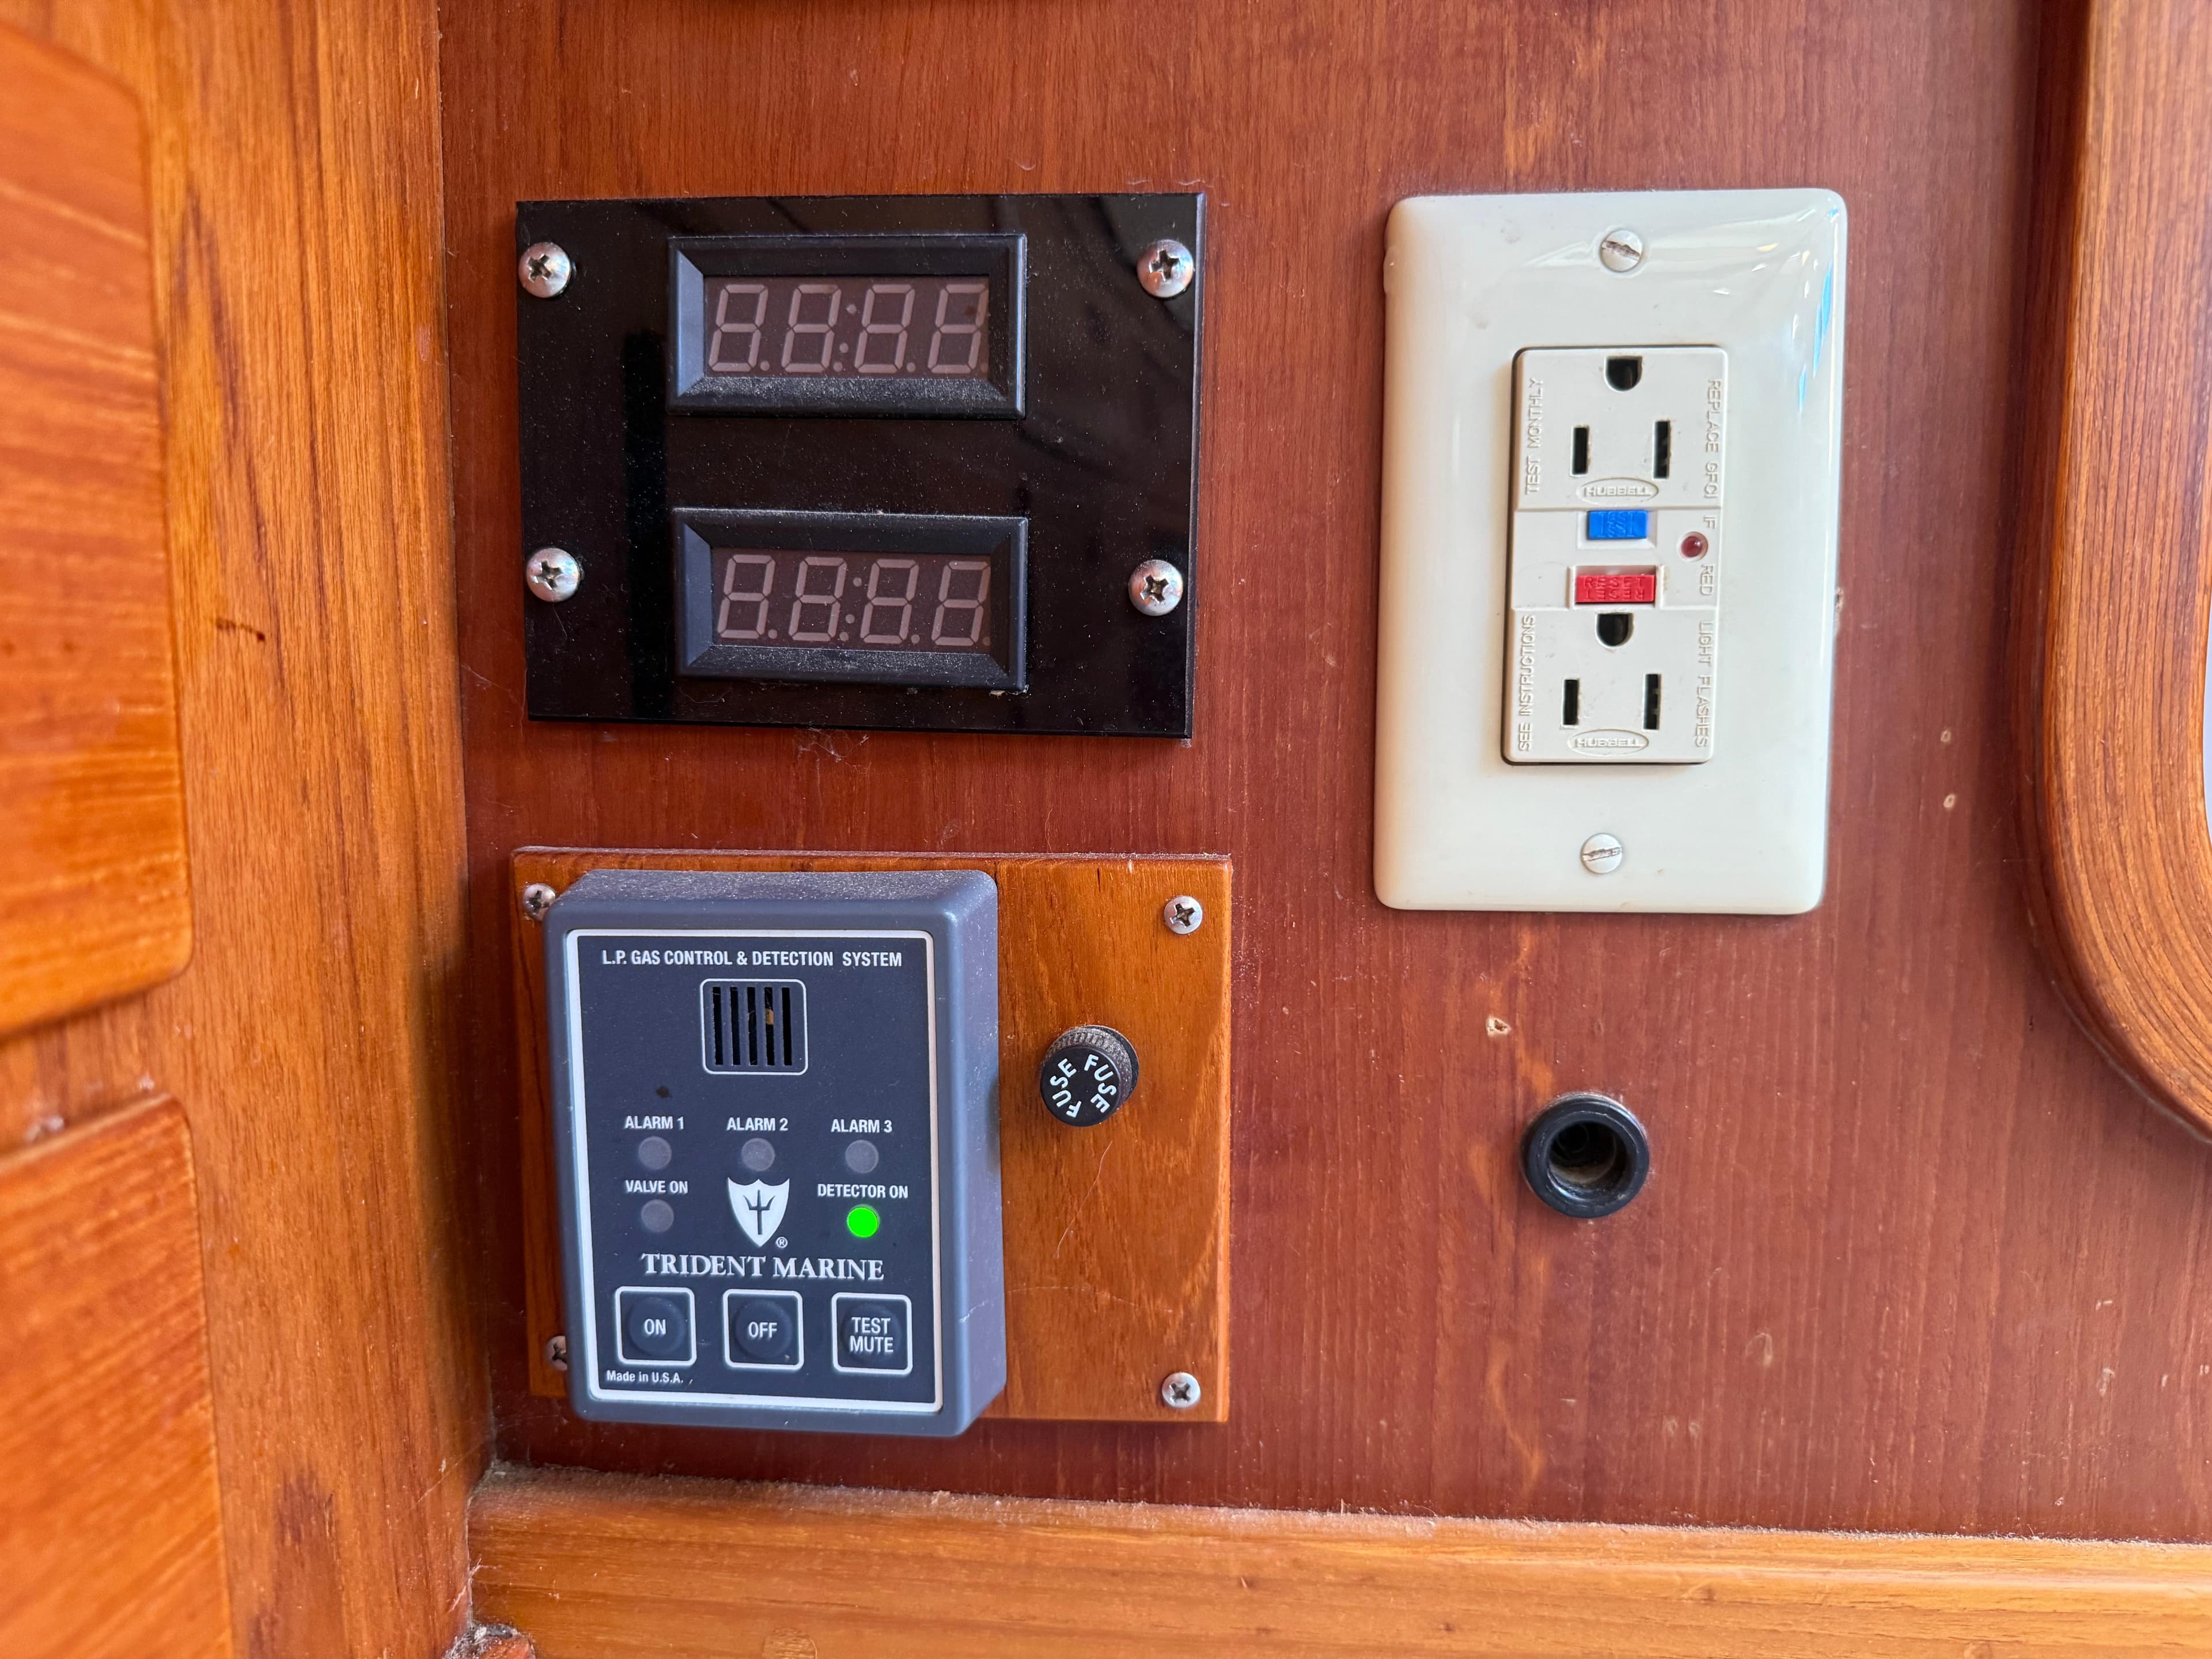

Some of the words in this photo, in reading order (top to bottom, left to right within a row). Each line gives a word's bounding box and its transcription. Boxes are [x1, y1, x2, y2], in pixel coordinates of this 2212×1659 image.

[1527, 378, 1543, 448] MONTHLY
[1705, 378, 1722, 453] REPLACE
[1525, 457, 1540, 495] TEST
[1704, 462, 1718, 499] GFCI
[1703, 516, 1717, 530] IF
[1699, 565, 1714, 596] RED
[1698, 622, 1713, 666] LIGHT
[1518, 615, 1535, 717] INSTRUCTIONS
[1695, 676, 1710, 748] FLASHES
[1518, 722, 1533, 751] SEE
[602, 950, 627, 965] L.P.
[631, 950, 660, 965] GAS
[664, 950, 732, 966] CONTROL
[736, 951, 748, 966] &
[752, 950, 834, 967] DETECTION
[842, 952, 903, 967] SYSTEM
[1050, 1058, 1082, 1118] FUSE
[1084, 1054, 1116, 1113] FUSE
[624, 1116, 673, 1130] ALARM
[677, 1116, 684, 1130] 1
[726, 1117, 776, 1131] ALARM
[779, 1118, 789, 1132] 2
[831, 1119, 880, 1133] ALARM
[883, 1120, 893, 1134] 3
[625, 1180, 667, 1194] VALVE
[669, 1180, 688, 1195] ON
[817, 1184, 887, 1198] DETECTOR
[889, 1185, 908, 1199] ON
[641, 1253, 766, 1277] TRIDENT
[772, 1257, 885, 1281] MARINE
[644, 1319, 666, 1335] ON
[748, 1322, 778, 1338] OFF
[851, 1317, 891, 1335] TEST
[849, 1336, 894, 1353] MUTE
[607, 1370, 637, 1382] Made
[638, 1371, 649, 1382] in
[652, 1371, 684, 1384] U.S.A.
